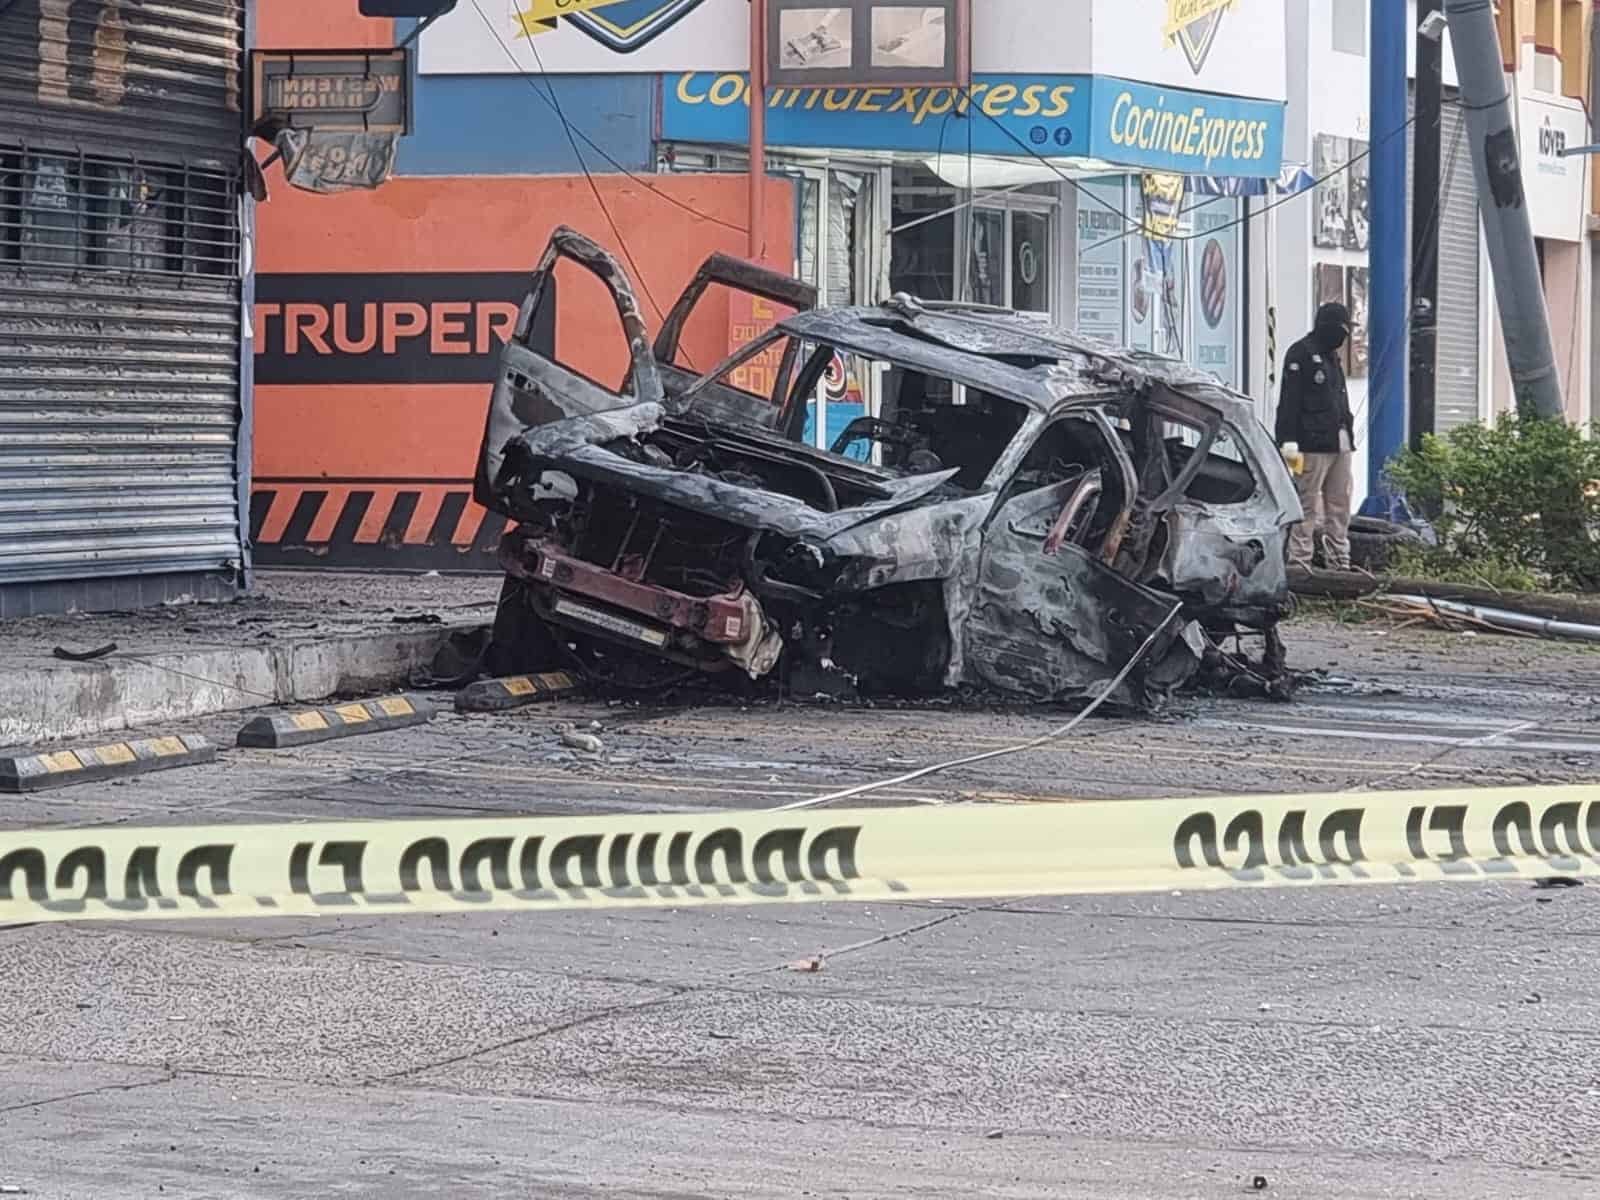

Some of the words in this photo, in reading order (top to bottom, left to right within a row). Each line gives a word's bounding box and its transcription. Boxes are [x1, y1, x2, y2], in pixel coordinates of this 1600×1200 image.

[676, 71, 1075, 125] CoinaExpress
[1110, 91, 1267, 170] CocinaExpress
[253, 302, 520, 354] TRUPER
